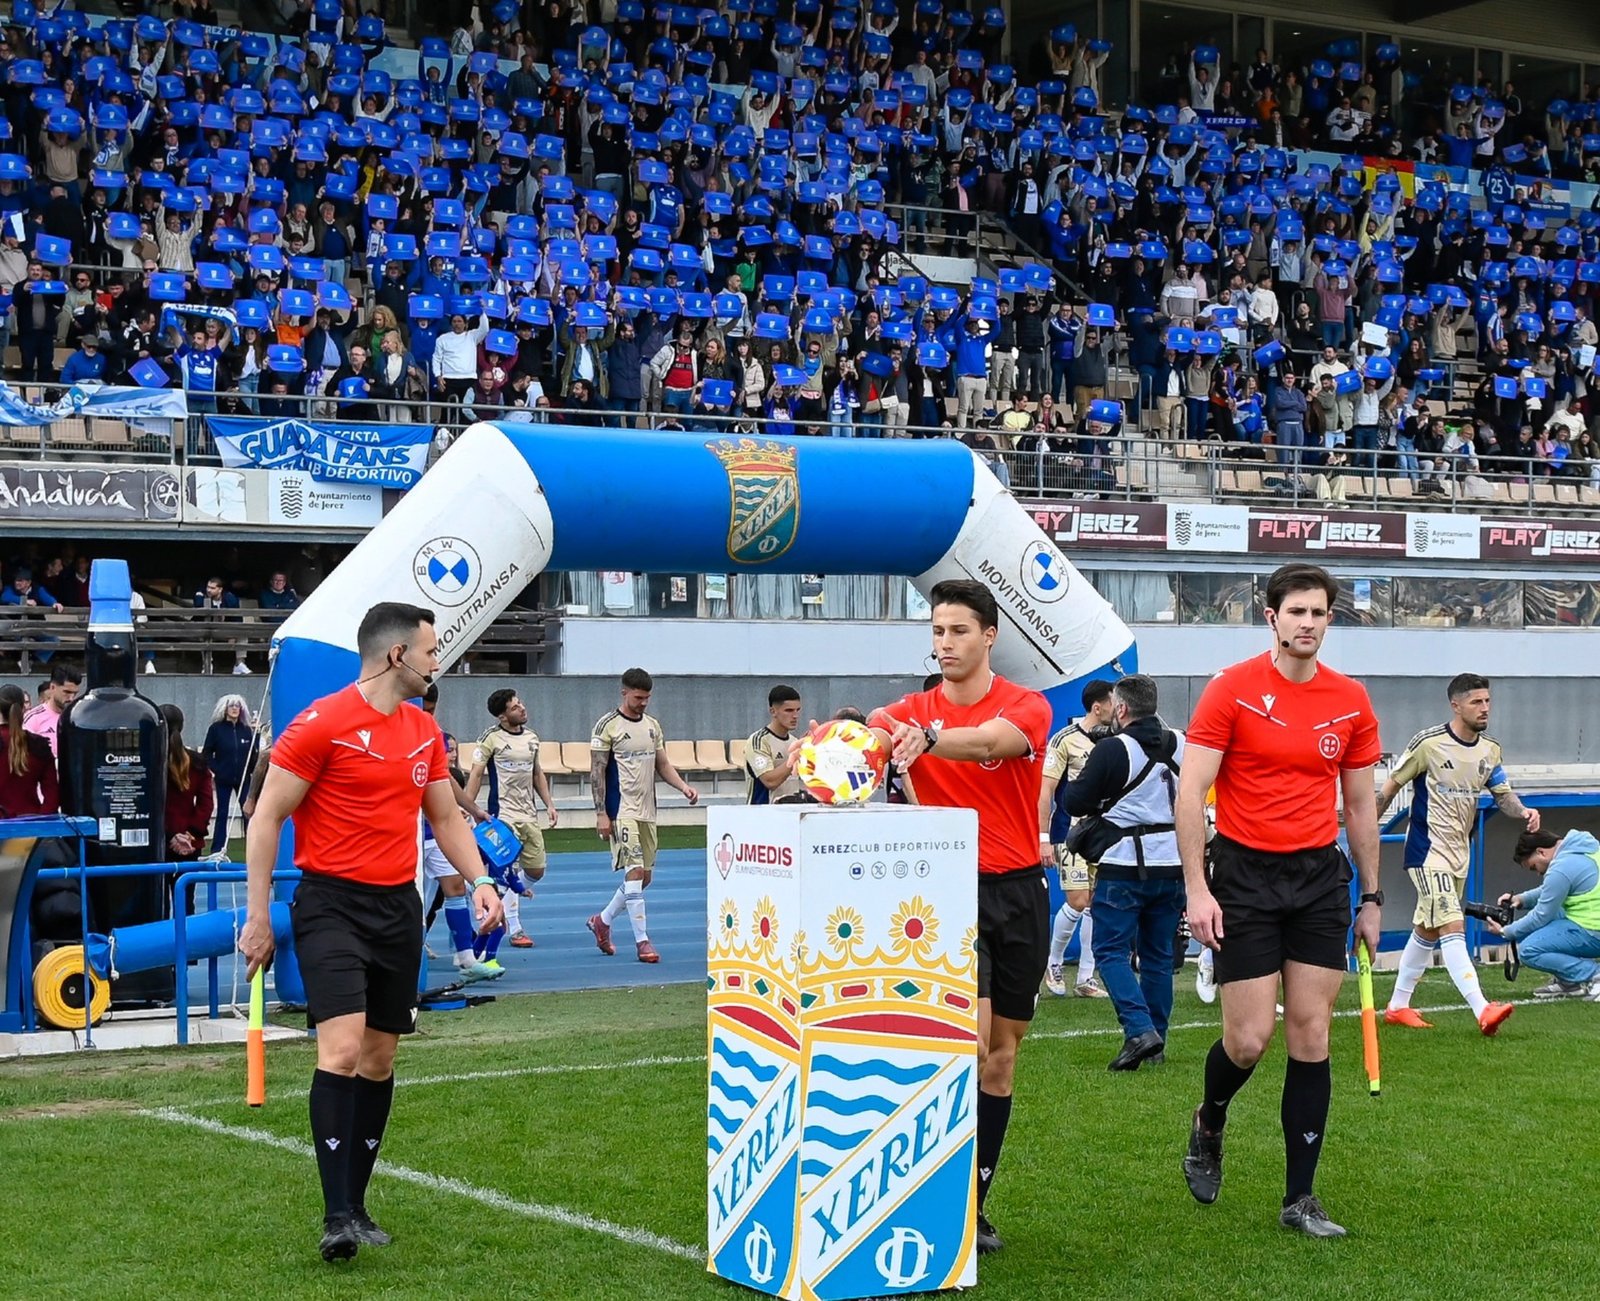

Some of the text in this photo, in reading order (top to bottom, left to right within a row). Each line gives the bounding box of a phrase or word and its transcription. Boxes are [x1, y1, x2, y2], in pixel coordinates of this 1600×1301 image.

[1491, 178, 1503, 194] 25
[333, 442, 410, 467] FANS
[325, 466, 412, 484] DEPORTIVO
[308, 491, 372, 502] Ayuntamiento
[321, 502, 344, 510] Jerez
[1034, 511, 1066, 530] AY
[1195, 522, 1241, 530] Ayuntamiento
[1258, 521, 1316, 538] PLAY
[1489, 528, 1541, 545] PLAY
[416, 540, 454, 576] BMW
[433, 562, 520, 657] MOVITRANSA
[978, 559, 1061, 648] MOVITRANSA
[105, 753, 141, 764] Canasta
[621, 827, 629, 843] 6
[735, 842, 793, 867] JMEDIS
[1433, 872, 1450, 893] 10
[712, 1074, 798, 1232] XEREZ
[811, 1064, 972, 1260] XEREZ
